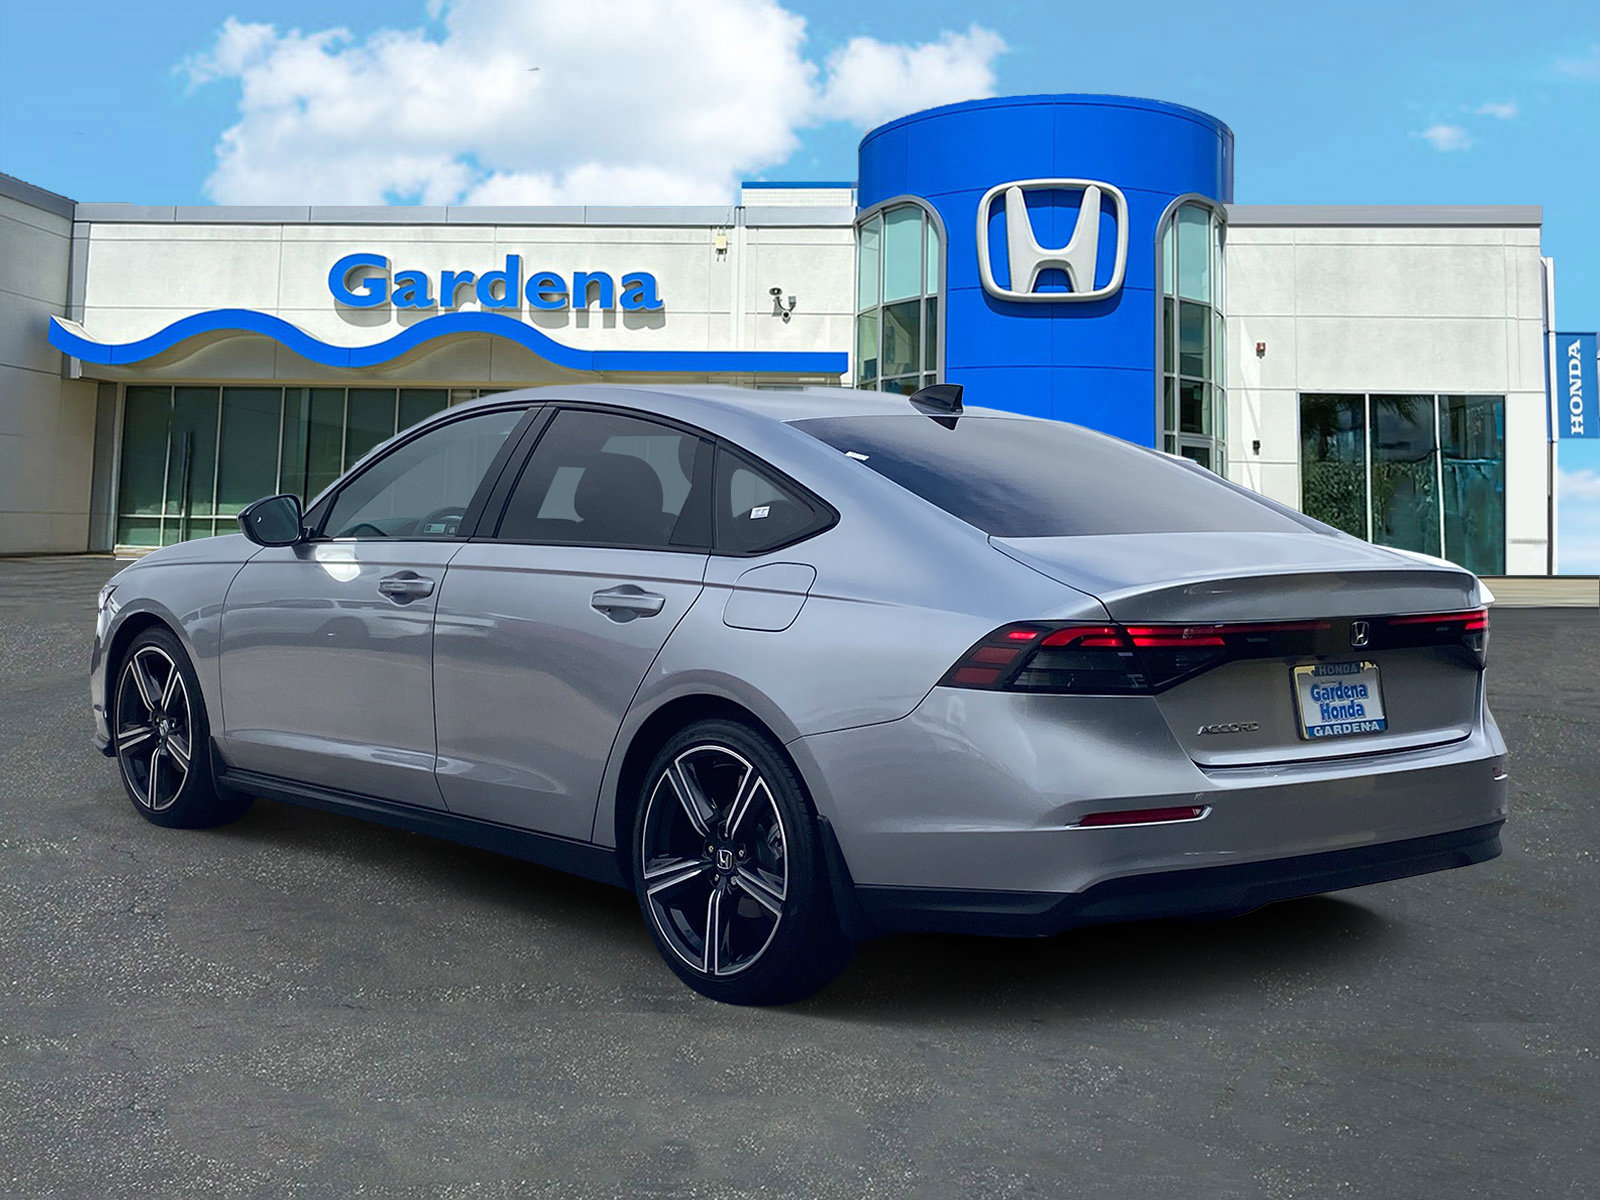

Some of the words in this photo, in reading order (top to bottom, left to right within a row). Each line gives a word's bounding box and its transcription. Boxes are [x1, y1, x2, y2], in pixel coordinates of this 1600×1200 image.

[328, 253, 663, 311] Gardena
[1568, 339, 1584, 435] HONDA
[1319, 664, 1357, 675] HONDA
[1310, 682, 1368, 702] Gardena
[1319, 701, 1365, 721] Honda
[1197, 722, 1259, 736] ACCORD
[1313, 721, 1380, 737] GARDENA
